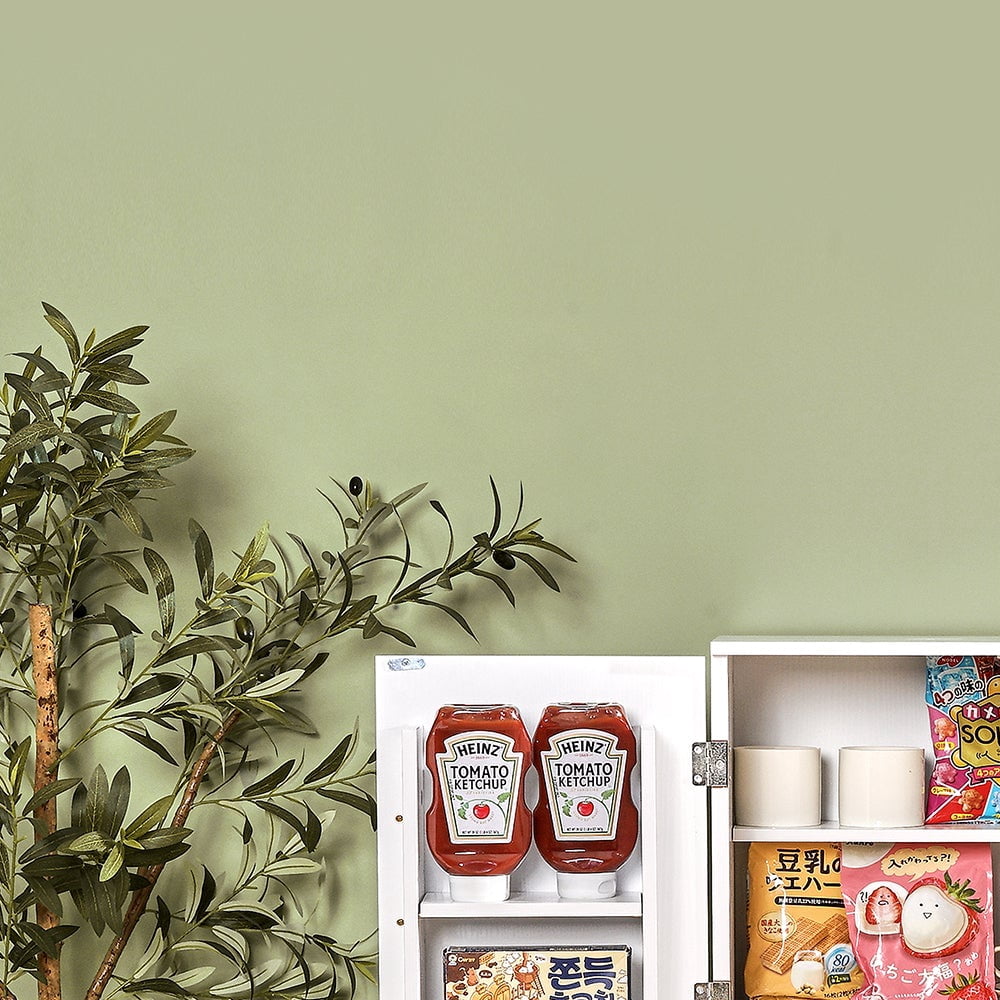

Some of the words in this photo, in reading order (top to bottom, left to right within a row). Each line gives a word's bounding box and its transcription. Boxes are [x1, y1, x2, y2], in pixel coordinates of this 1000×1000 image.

[933, 678, 985, 705] 4つの味の
[456, 742, 500, 757] HEINZ
[561, 740, 604, 755] HEINZ
[450, 765, 509, 779] TOMATO
[554, 762, 613, 776] TOMATO
[454, 779, 507, 790] KETCHUP
[559, 776, 611, 788] KETCHUP
[833, 953, 850, 967] 80
